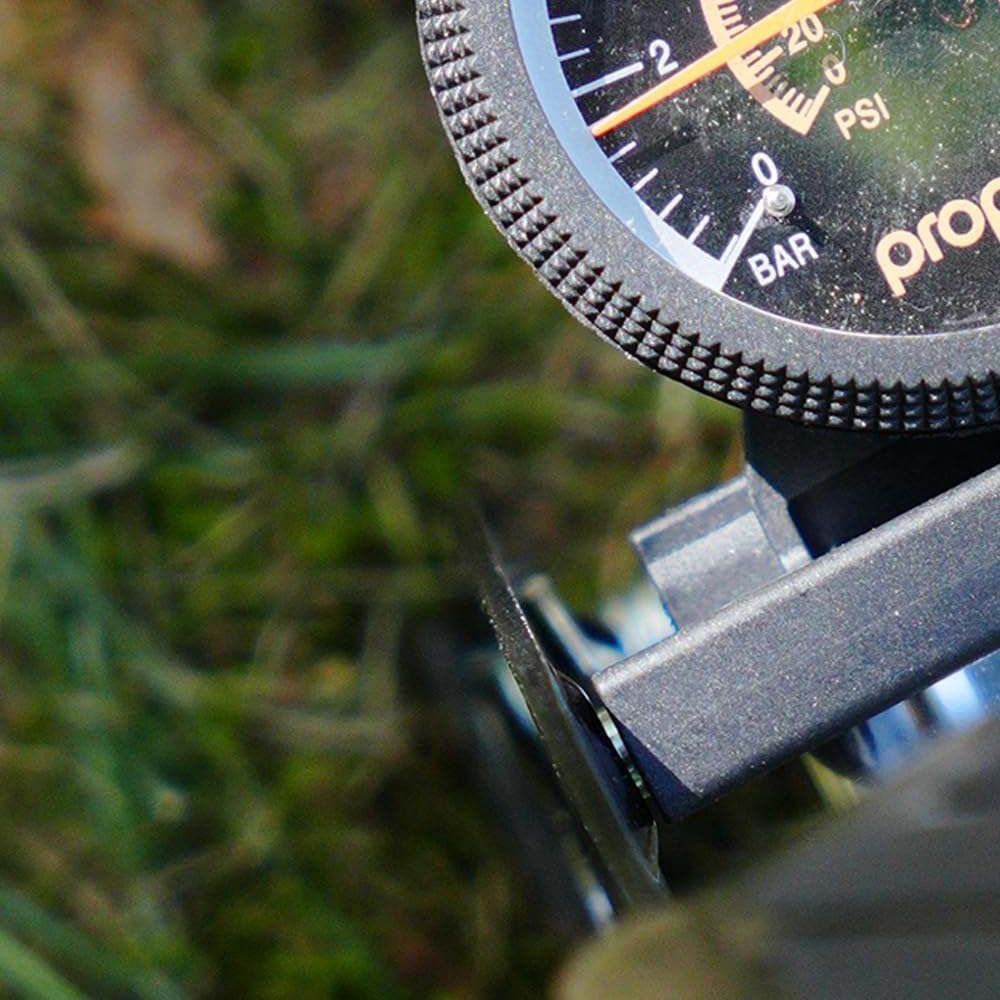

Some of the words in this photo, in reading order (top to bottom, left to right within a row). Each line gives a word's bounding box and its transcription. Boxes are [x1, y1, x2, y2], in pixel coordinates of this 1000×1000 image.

[781, 14, 824, 56] 20
[649, 39, 678, 76] 2
[822, 55, 847, 85] 0
[834, 93, 890, 140] PSI
[750, 151, 779, 186] 0
[748, 232, 819, 288] BAR
